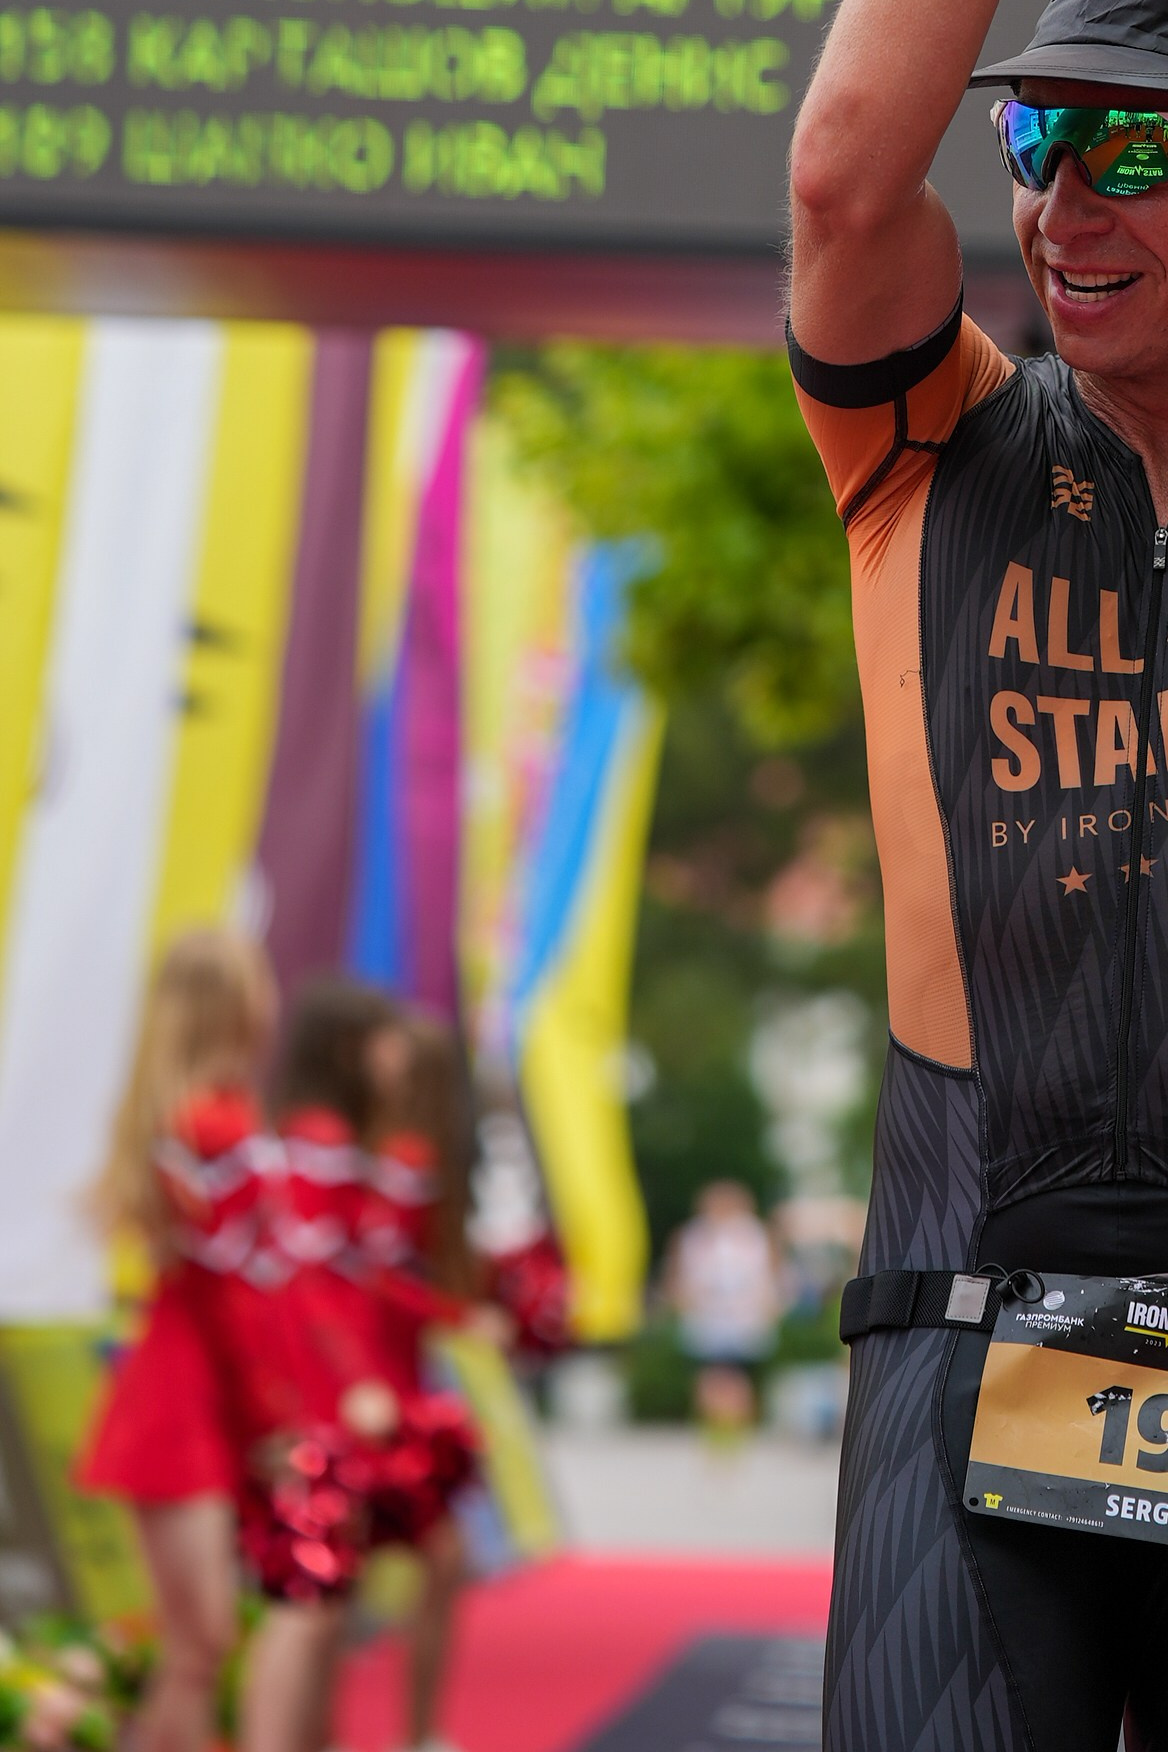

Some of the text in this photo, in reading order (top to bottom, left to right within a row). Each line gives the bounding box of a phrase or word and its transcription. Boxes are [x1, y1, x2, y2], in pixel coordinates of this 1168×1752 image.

[987, 560, 1145, 675] ALL
[991, 819, 1036, 848] BY
[1015, 1313, 1085, 1327] ГАЗПРОМБАНК
[1025, 1321, 1072, 1333] ПРЕМИУМ
[1145, 1338, 1162, 1347] 2023
[1006, 1505, 1037, 1517] EMERGENCY
[1037, 1511, 1063, 1521] CONTACT:
